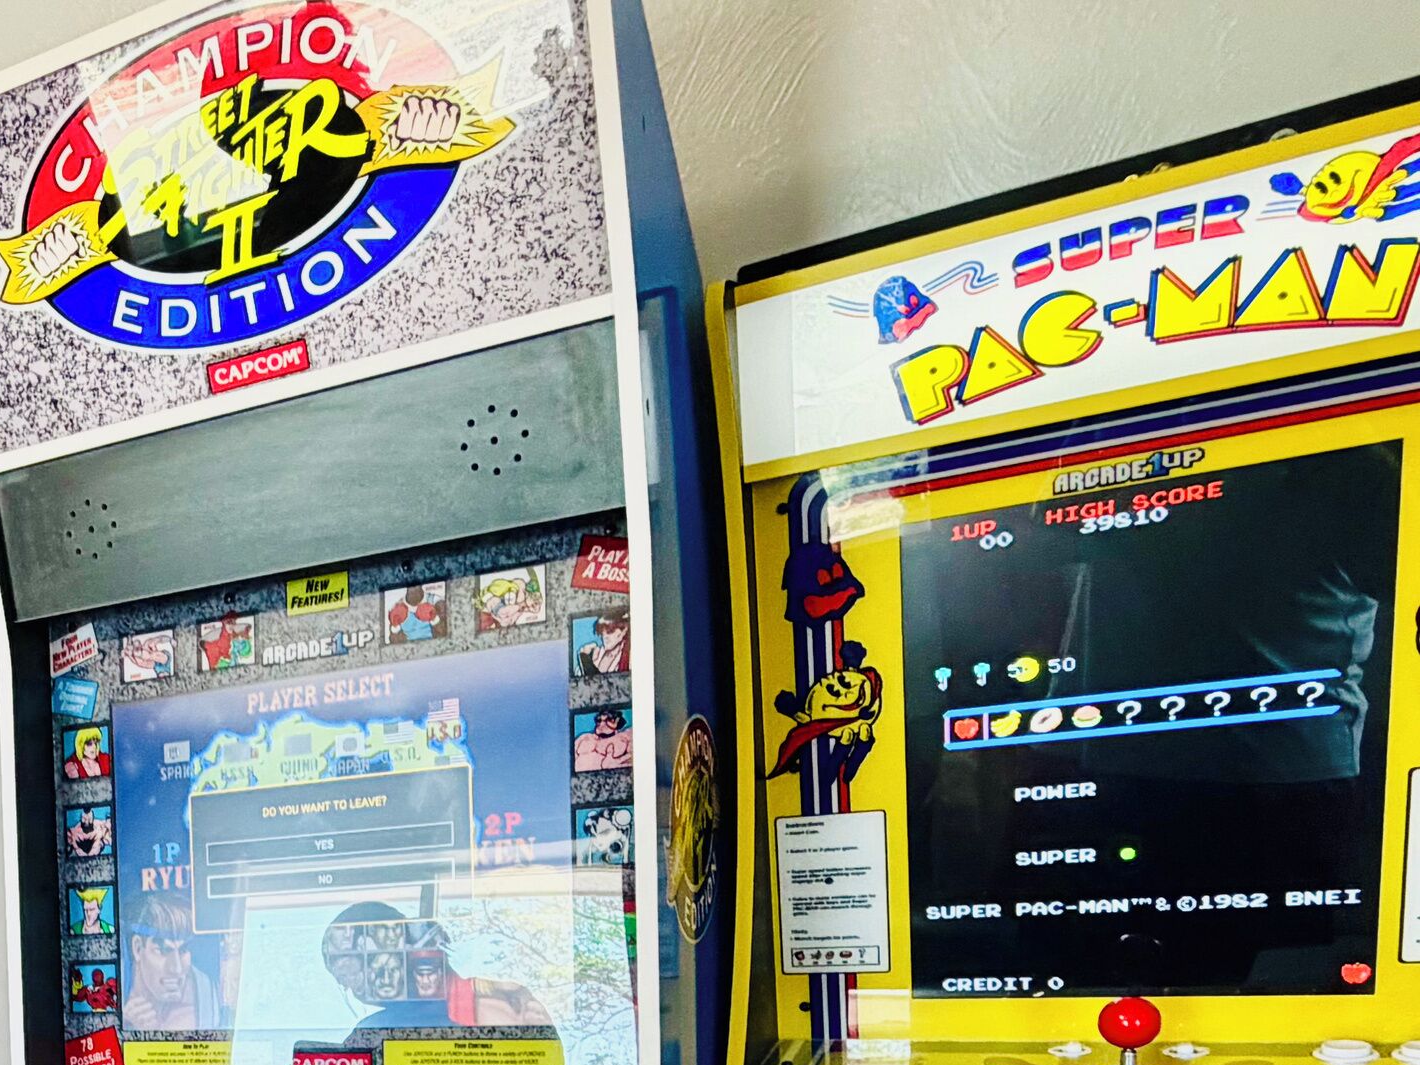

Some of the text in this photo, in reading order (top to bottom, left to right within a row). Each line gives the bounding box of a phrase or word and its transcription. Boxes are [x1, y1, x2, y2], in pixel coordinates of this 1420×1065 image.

[54, 17, 397, 193] CHAMPION
[102, 73, 259, 195] STREET
[99, 78, 370, 250] FIGHTER
[202, 189, 282, 285] II
[1012, 194, 1251, 288] SUPER
[112, 205, 398, 337] EDITION
[890, 238, 1420, 425] PAC-MAN
[1053, 447, 1205, 495] ARCADE1UP
[1045, 480, 1225, 525] HIGH SCORE
[950, 519, 997, 541] 1UP
[1079, 506, 1169, 535] 39810
[979, 531, 1013, 550] 00
[588, 544, 624, 564] PLAY
[305, 578, 330, 594] NEW
[291, 588, 344, 609] FEATURES!
[1047, 656, 1076, 674] 50
[247, 672, 395, 715] PLAYER SELECT
[1014, 781, 1097, 802] POWER
[262, 795, 388, 818] DO YOU WANT TO LEAVE?
[483, 811, 523, 836] 2P
[151, 842, 181, 865] 1P
[314, 840, 335, 852] YES
[1015, 848, 1097, 866] SUPER
[141, 865, 193, 892] RYU
[318, 874, 333, 886] NO
[926, 903, 1002, 920] SUPER
[1285, 888, 1362, 907] BNEI
[942, 976, 1064, 992] CREDIT 0
[80, 1037, 94, 1053] 78
